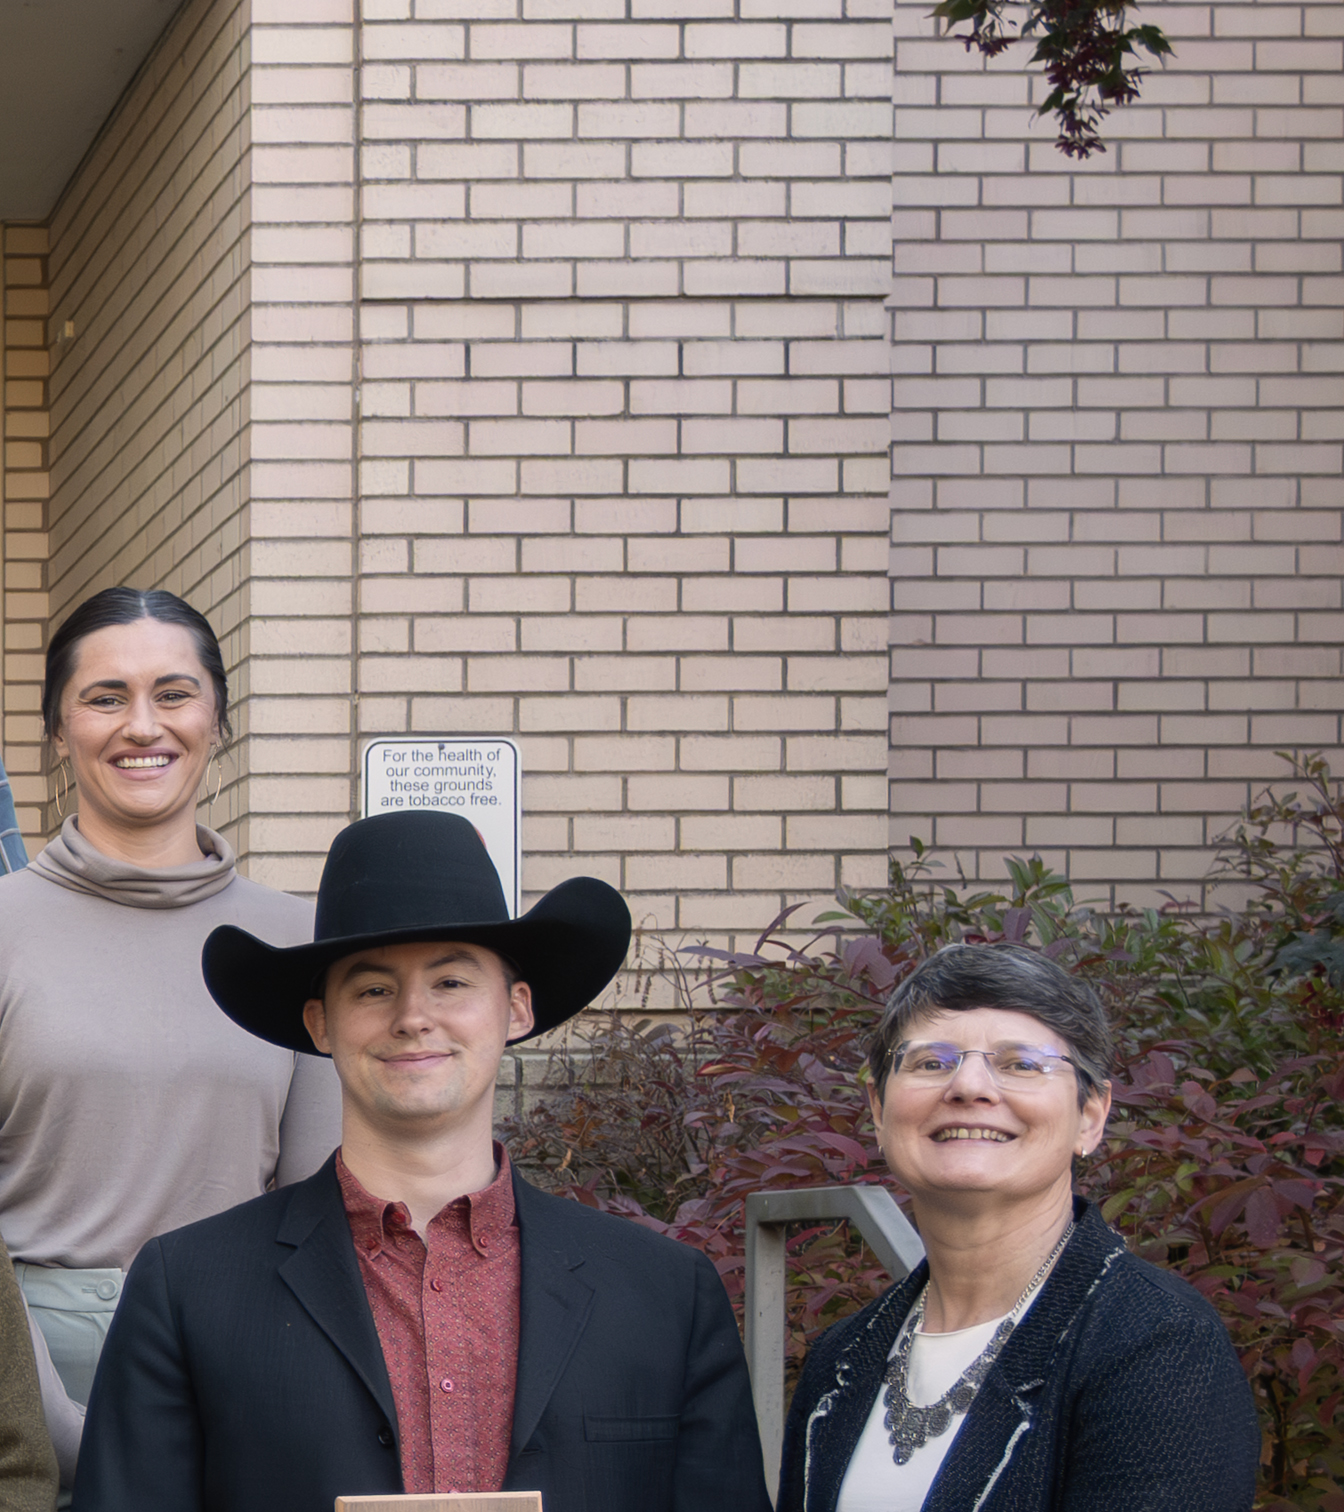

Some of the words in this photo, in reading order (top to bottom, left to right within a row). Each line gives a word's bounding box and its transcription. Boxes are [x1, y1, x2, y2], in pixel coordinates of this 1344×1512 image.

[383, 750, 406, 762] For
[412, 750, 433, 762] the
[438, 749, 482, 762] health
[487, 748, 502, 761] of
[386, 766, 410, 777] our
[414, 765, 496, 778] community,
[390, 780, 429, 792] these
[434, 778, 492, 794] grounds
[381, 796, 404, 806] are
[409, 794, 466, 806] tobacco
[470, 793, 502, 806] free.
